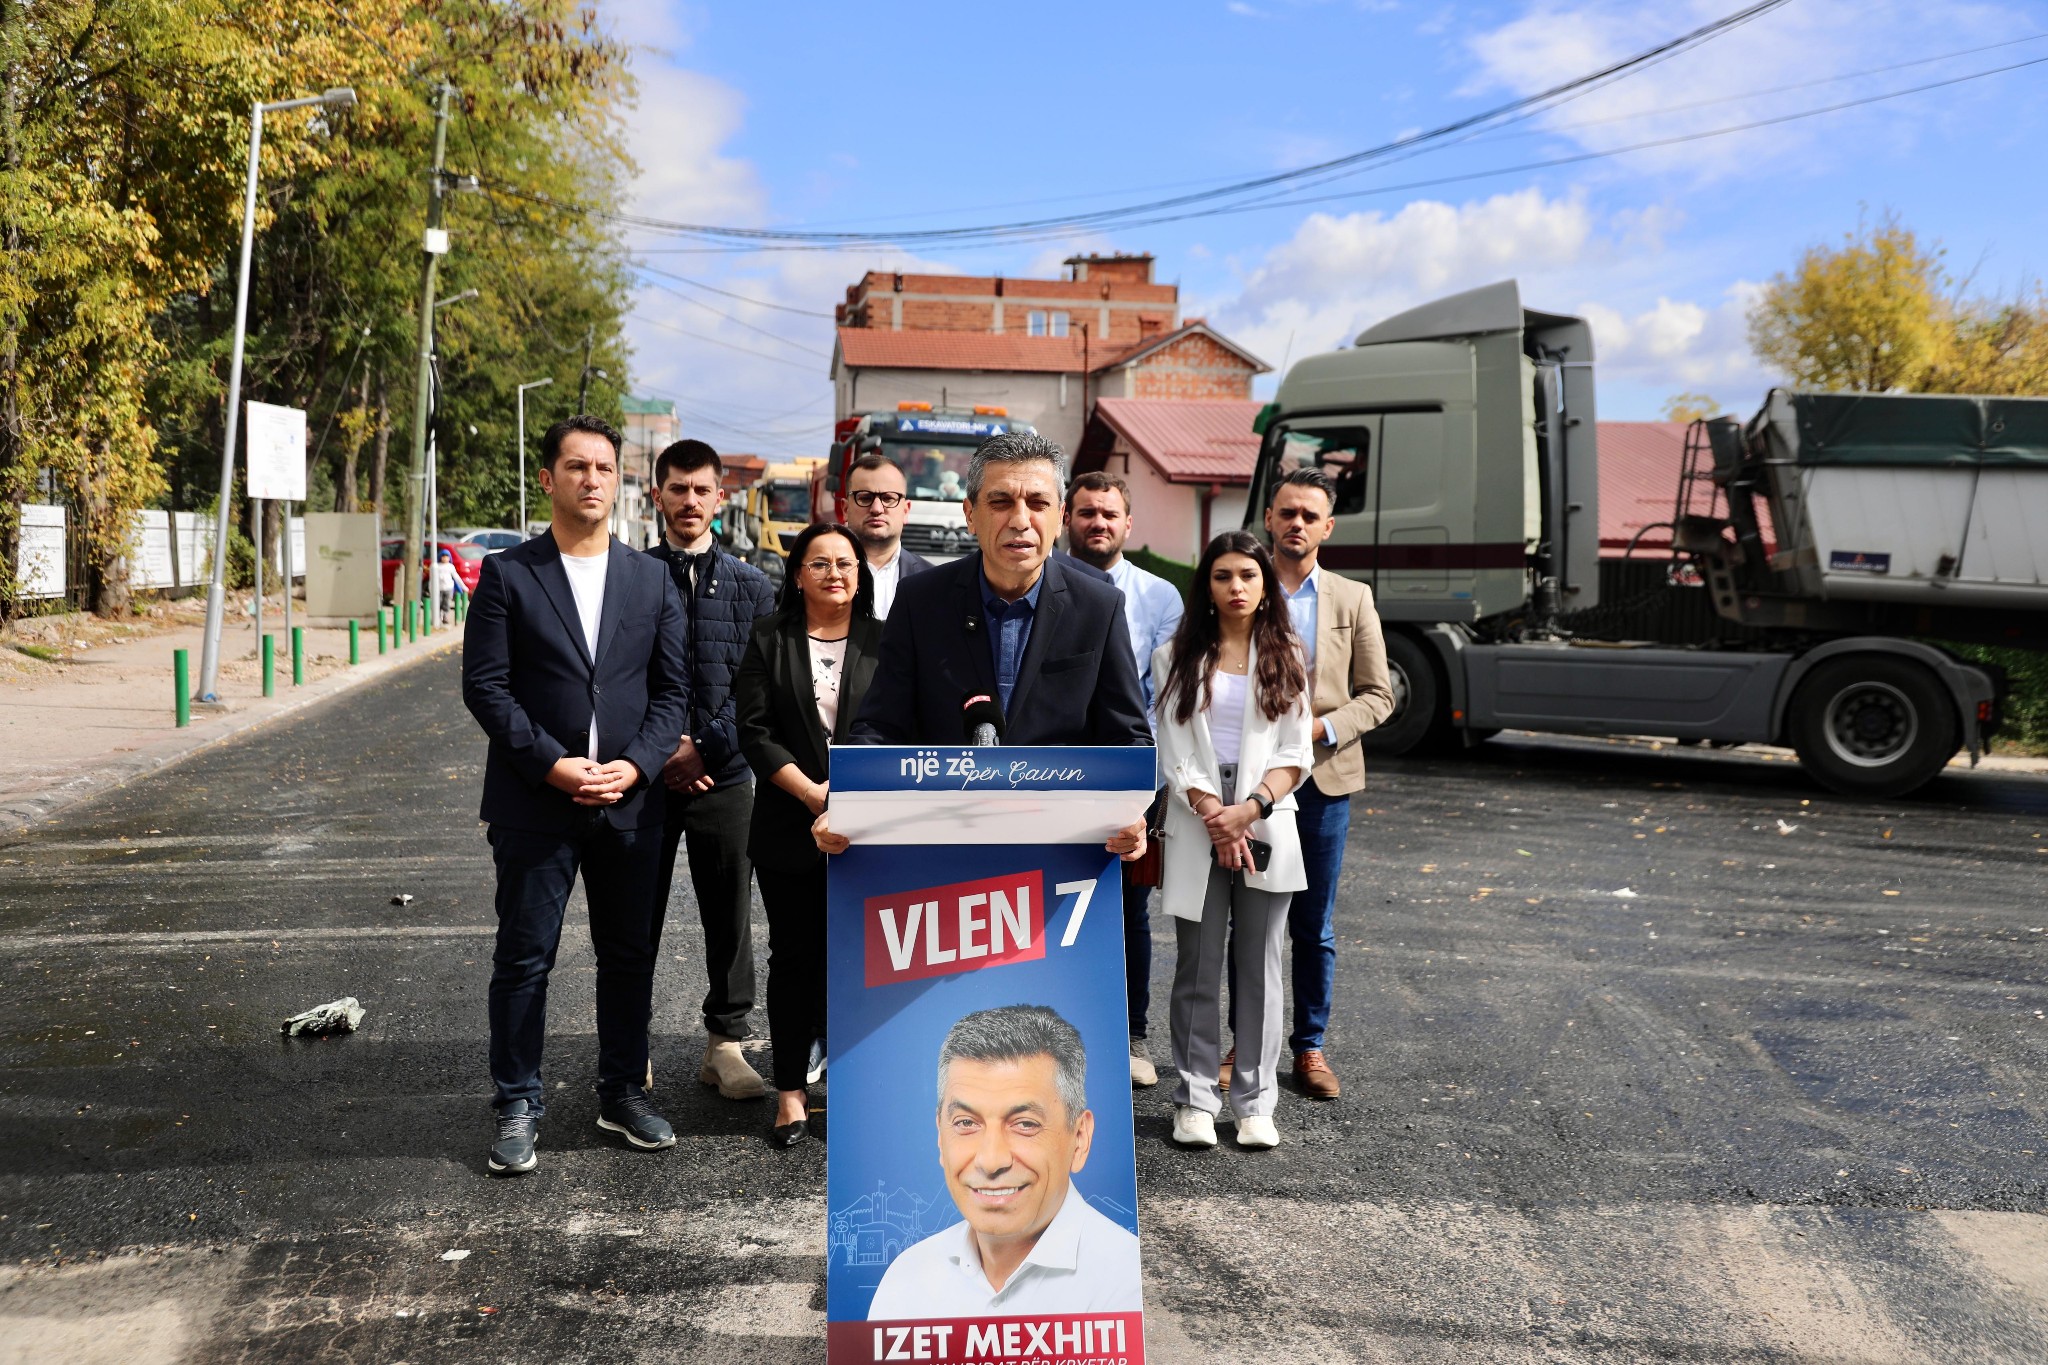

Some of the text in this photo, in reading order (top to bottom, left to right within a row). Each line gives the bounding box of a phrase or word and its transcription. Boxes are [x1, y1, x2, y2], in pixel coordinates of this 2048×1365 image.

[900, 751, 1085, 790] një zë për Çairin
[879, 878, 1097, 971] VLEN 7
[873, 1319, 1126, 1361] IZET MEXHITI
